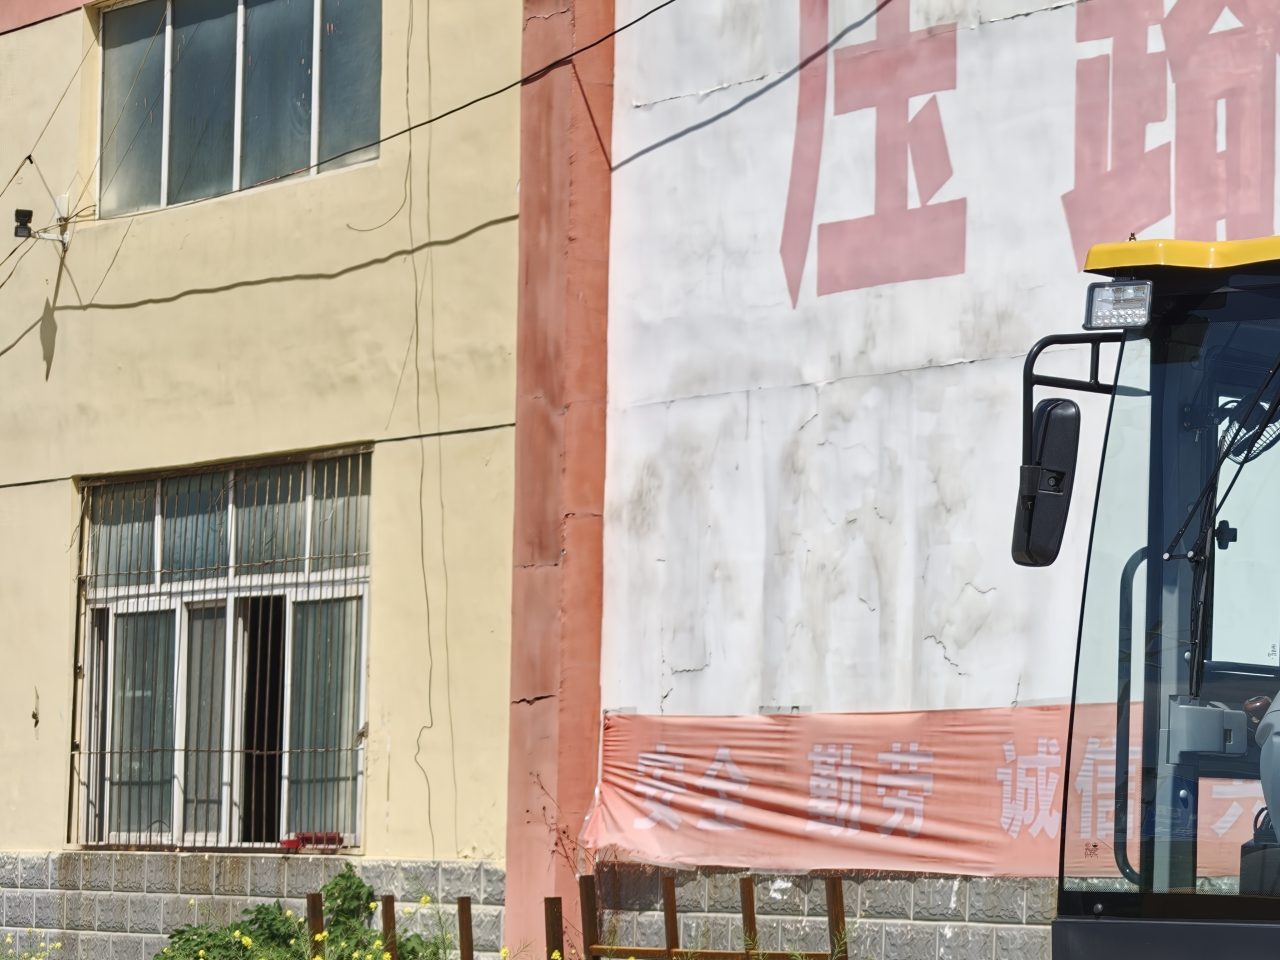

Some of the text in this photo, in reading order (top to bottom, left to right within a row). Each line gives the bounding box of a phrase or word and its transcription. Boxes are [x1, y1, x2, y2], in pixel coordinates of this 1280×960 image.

[633, 743, 750, 831] 安全
[806, 743, 933, 838] 勤劳
[996, 736, 1142, 839] 诚信
